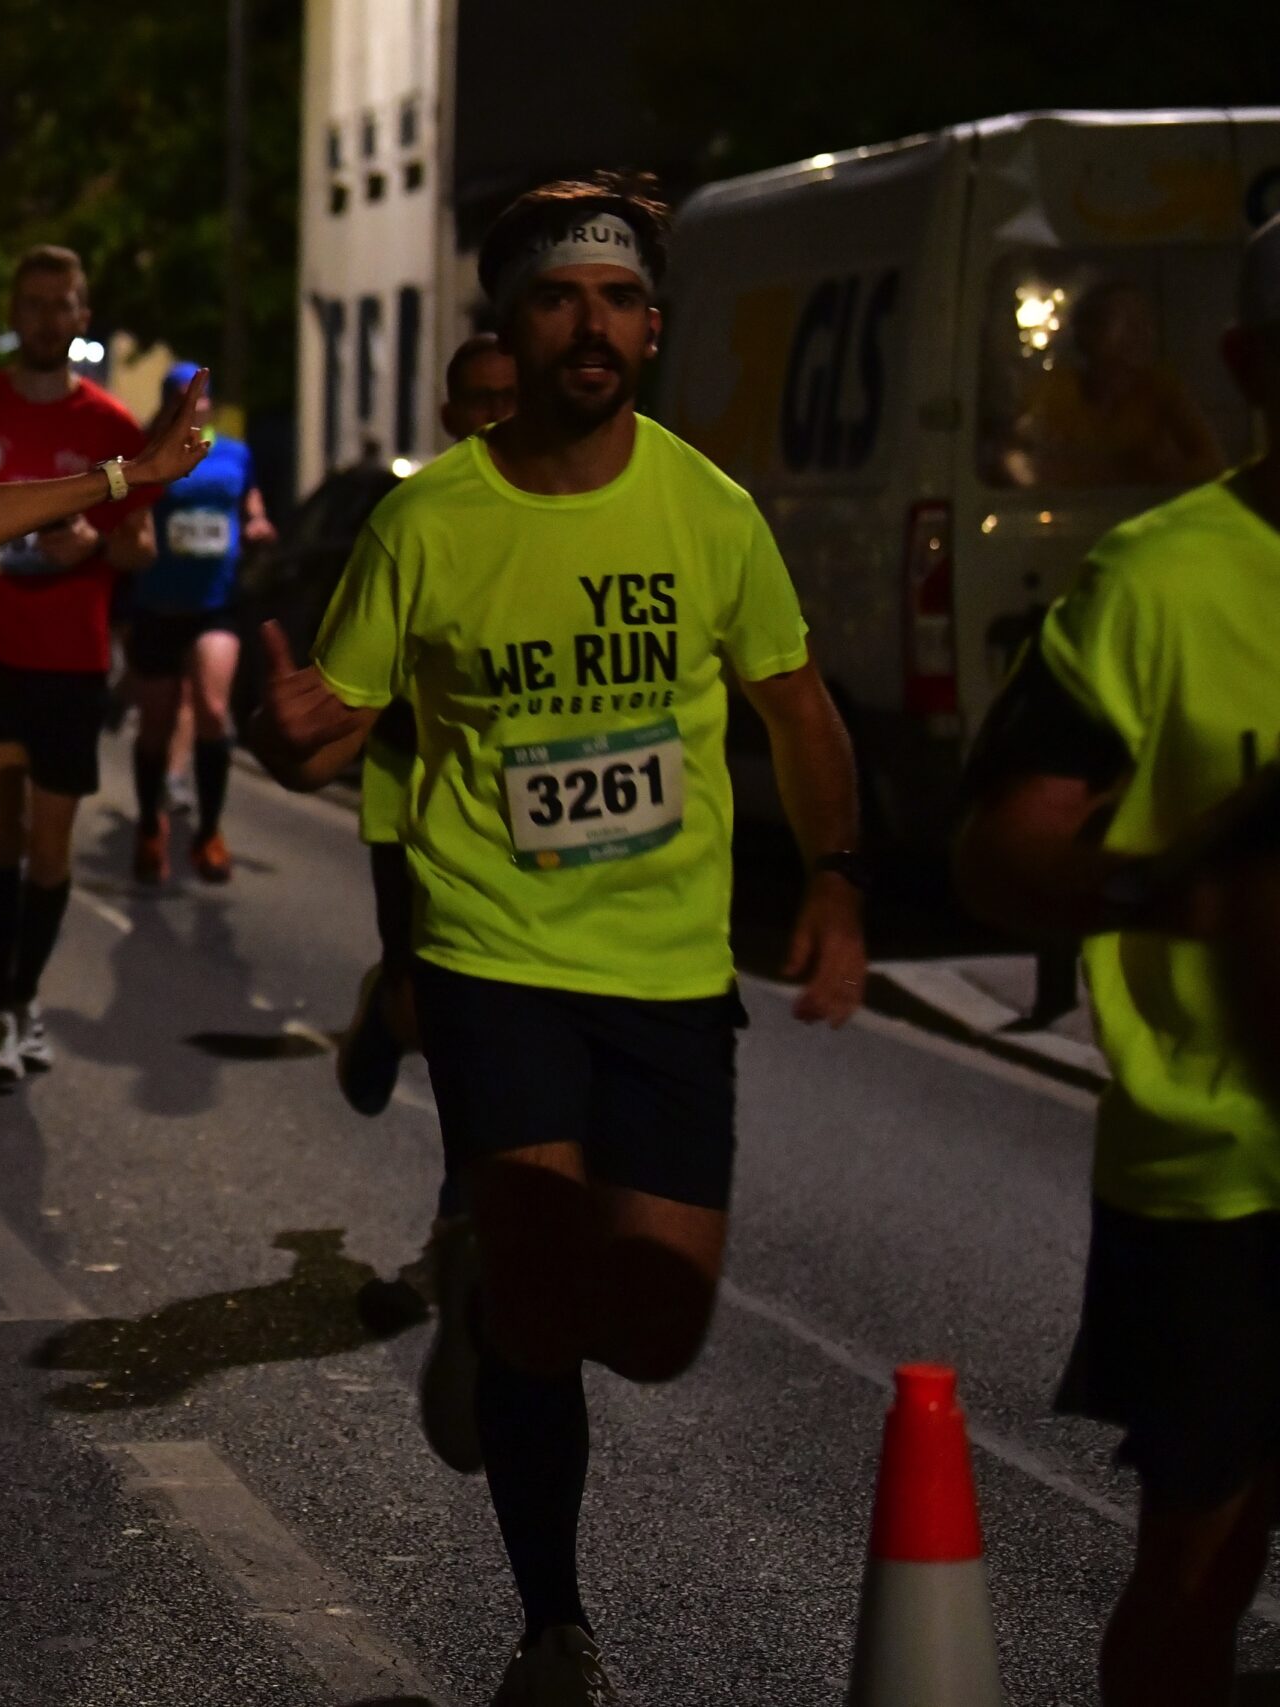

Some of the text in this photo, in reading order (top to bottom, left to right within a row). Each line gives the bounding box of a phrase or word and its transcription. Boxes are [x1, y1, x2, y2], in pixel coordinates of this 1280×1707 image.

[782, 267, 899, 471] GLS
[578, 573, 677, 627] YES
[480, 630, 678, 697] WE RUN
[488, 690, 675, 721] COURBEVOIE
[526, 754, 664, 827] 3261
